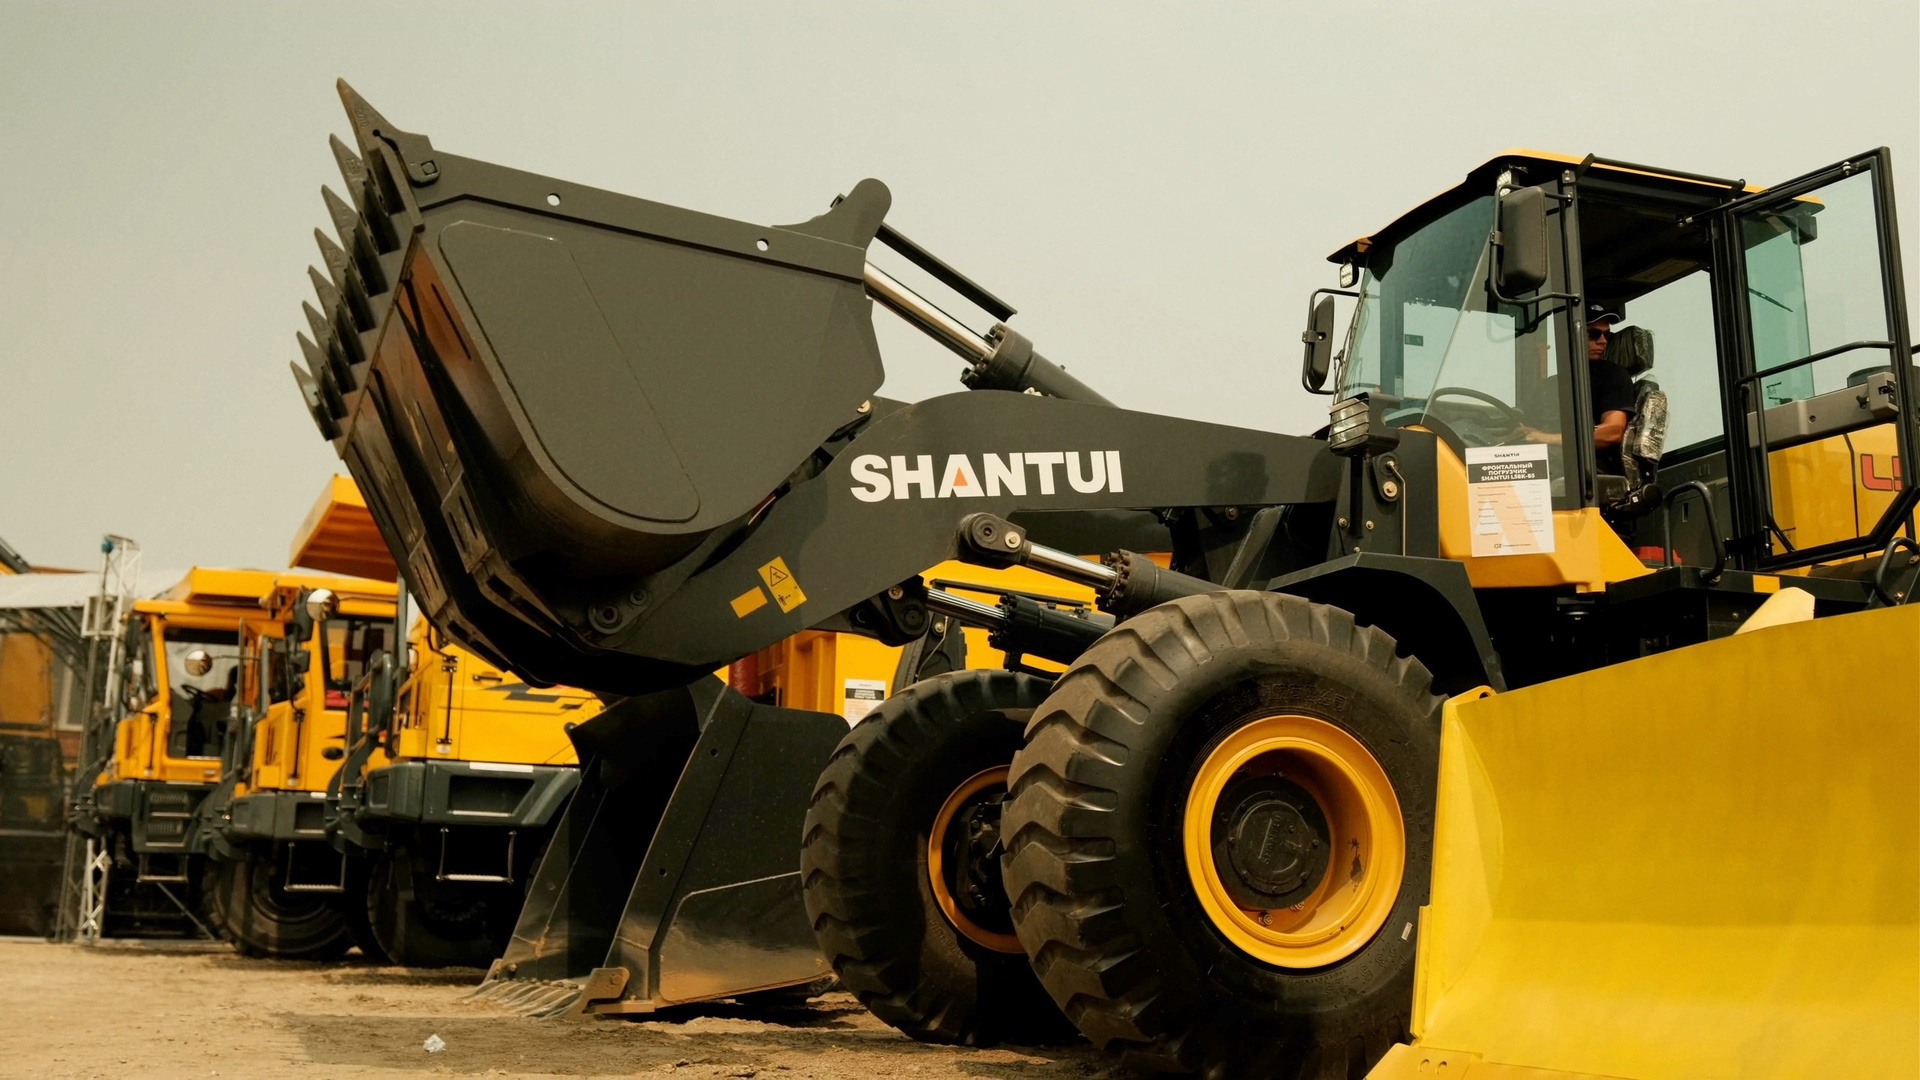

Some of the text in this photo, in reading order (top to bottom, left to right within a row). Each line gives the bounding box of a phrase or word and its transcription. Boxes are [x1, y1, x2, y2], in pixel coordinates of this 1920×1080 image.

[1481, 462, 1533, 471] ФРОНТАЛЬНЫЙ
[850, 450, 1124, 503] SHANTUI
[1488, 468, 1527, 476] ПОГРУЗЧИК
